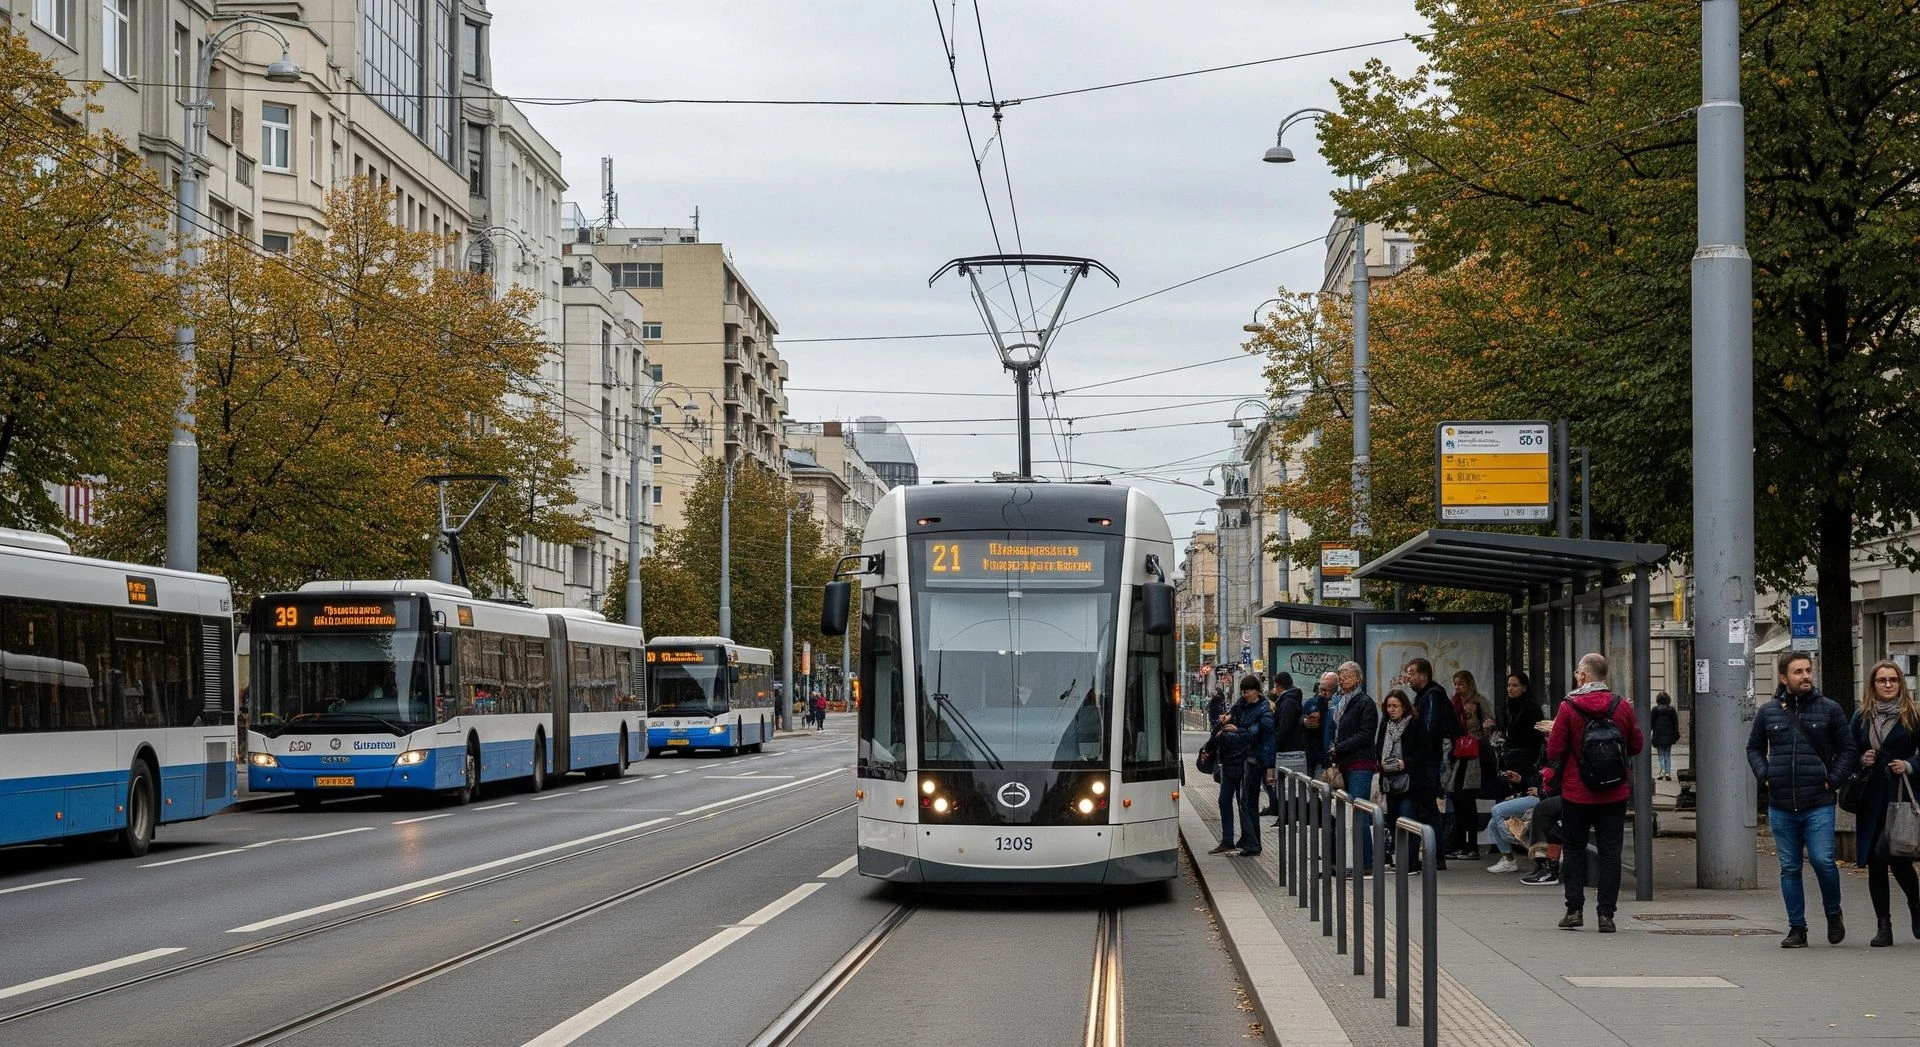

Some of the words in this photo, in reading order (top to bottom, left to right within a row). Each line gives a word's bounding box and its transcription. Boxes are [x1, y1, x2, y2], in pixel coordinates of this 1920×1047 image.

[932, 544, 961, 572] 21
[275, 606, 297, 626] 39
[1797, 598, 1809, 616] P
